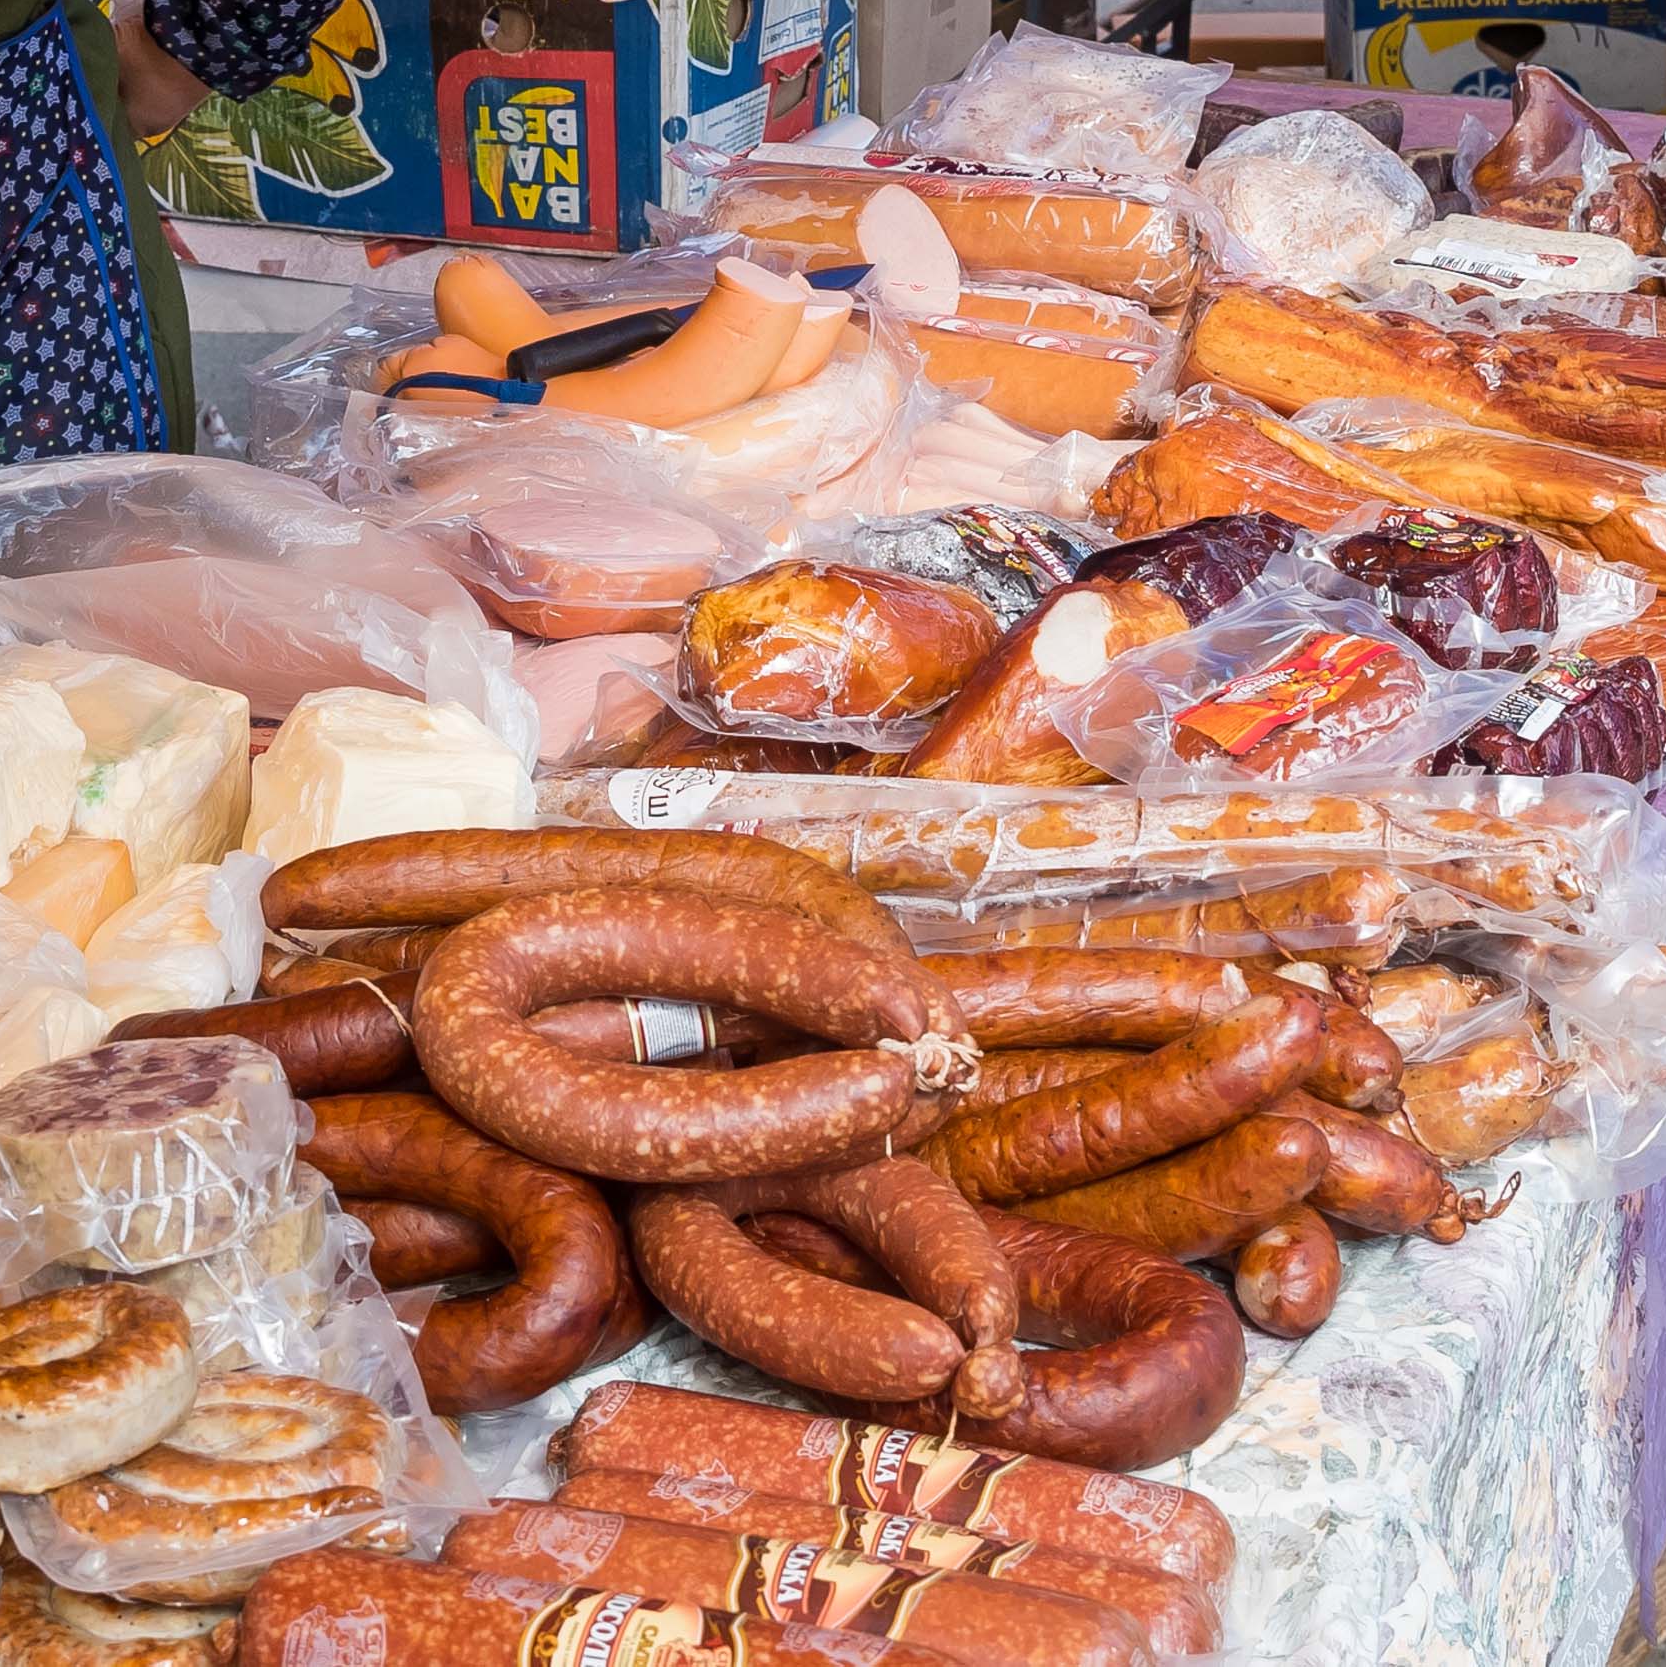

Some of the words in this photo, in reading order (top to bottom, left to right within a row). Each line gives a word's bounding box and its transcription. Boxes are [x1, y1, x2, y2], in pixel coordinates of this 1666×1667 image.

[474, 105, 578, 146] BEST
[508, 145, 580, 185] NA
[508, 182, 581, 224] BA
